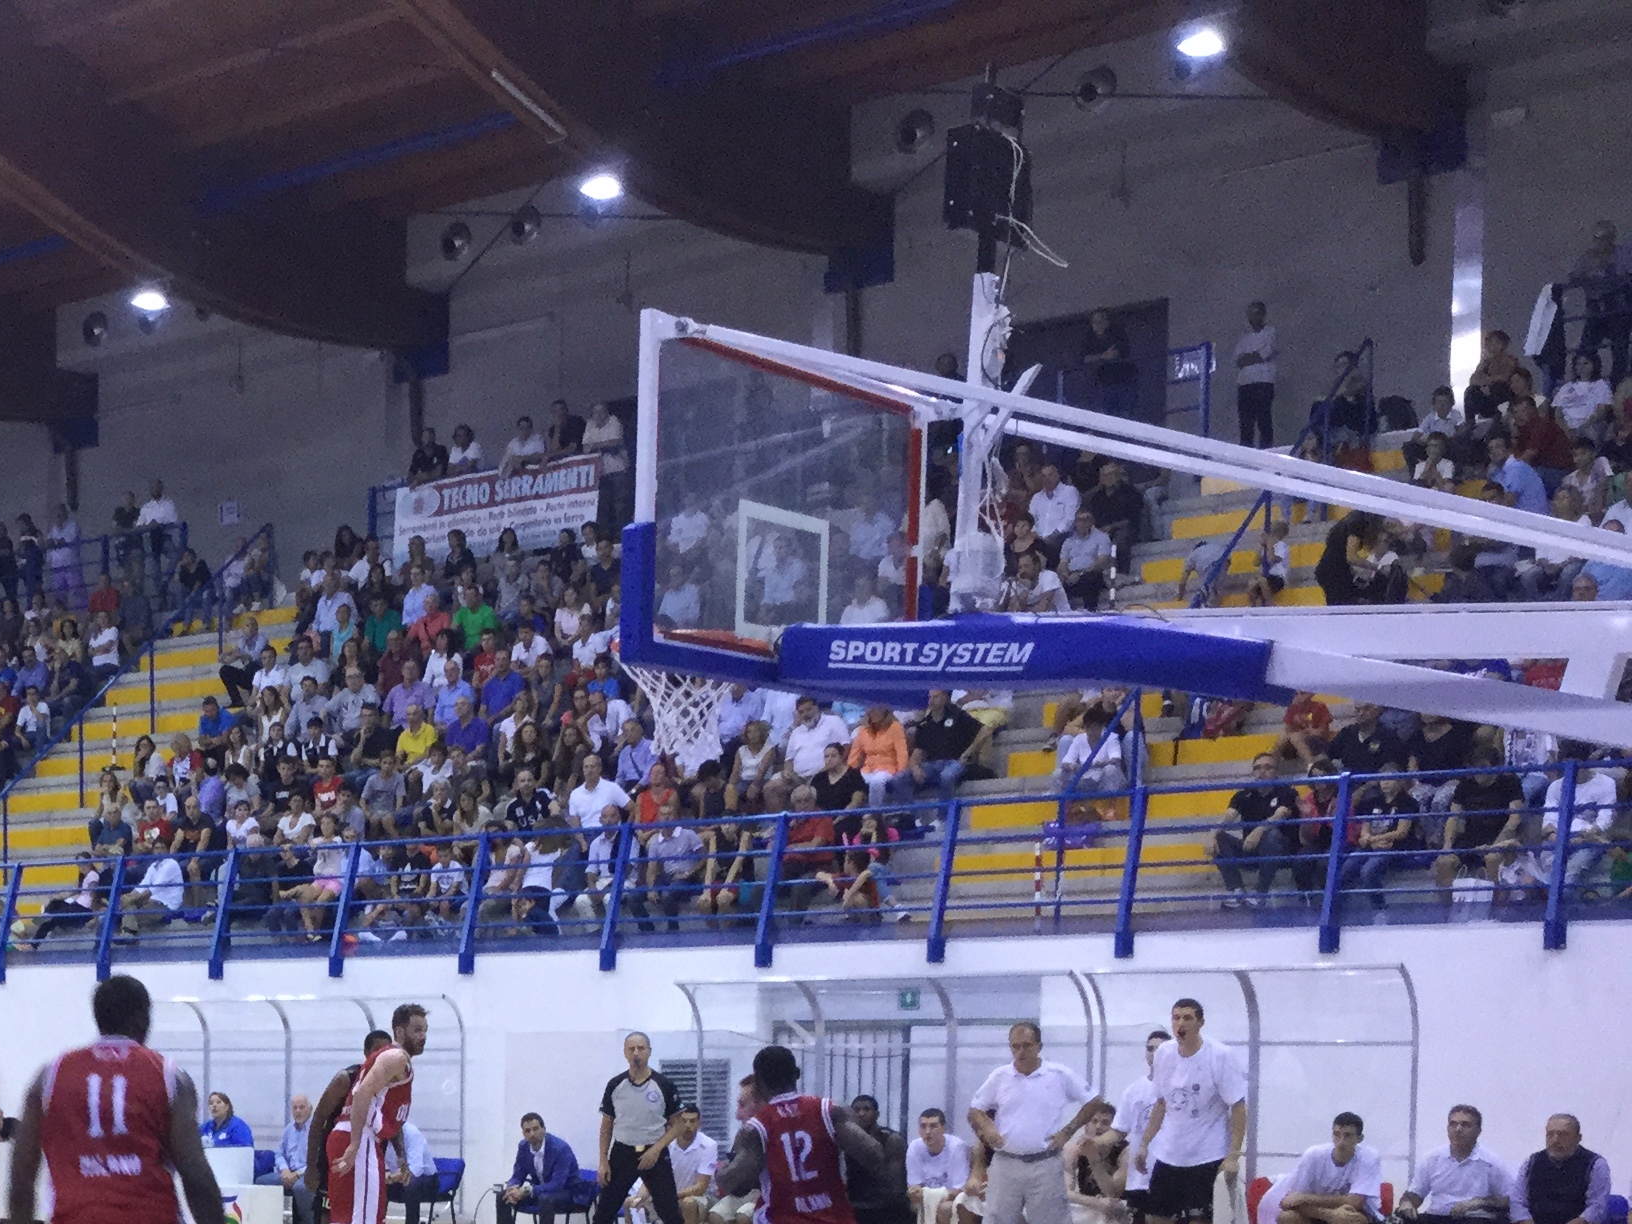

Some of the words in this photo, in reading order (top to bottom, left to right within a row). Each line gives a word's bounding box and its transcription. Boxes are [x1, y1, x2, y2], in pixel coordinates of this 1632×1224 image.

[442, 482, 490, 511] TECNO
[494, 464, 595, 502] SERRAMENTI
[829, 640, 919, 663] SPORT
[919, 642, 1035, 671] SYSTEM
[86, 1073, 128, 1138] 11
[780, 1130, 819, 1182] 12
